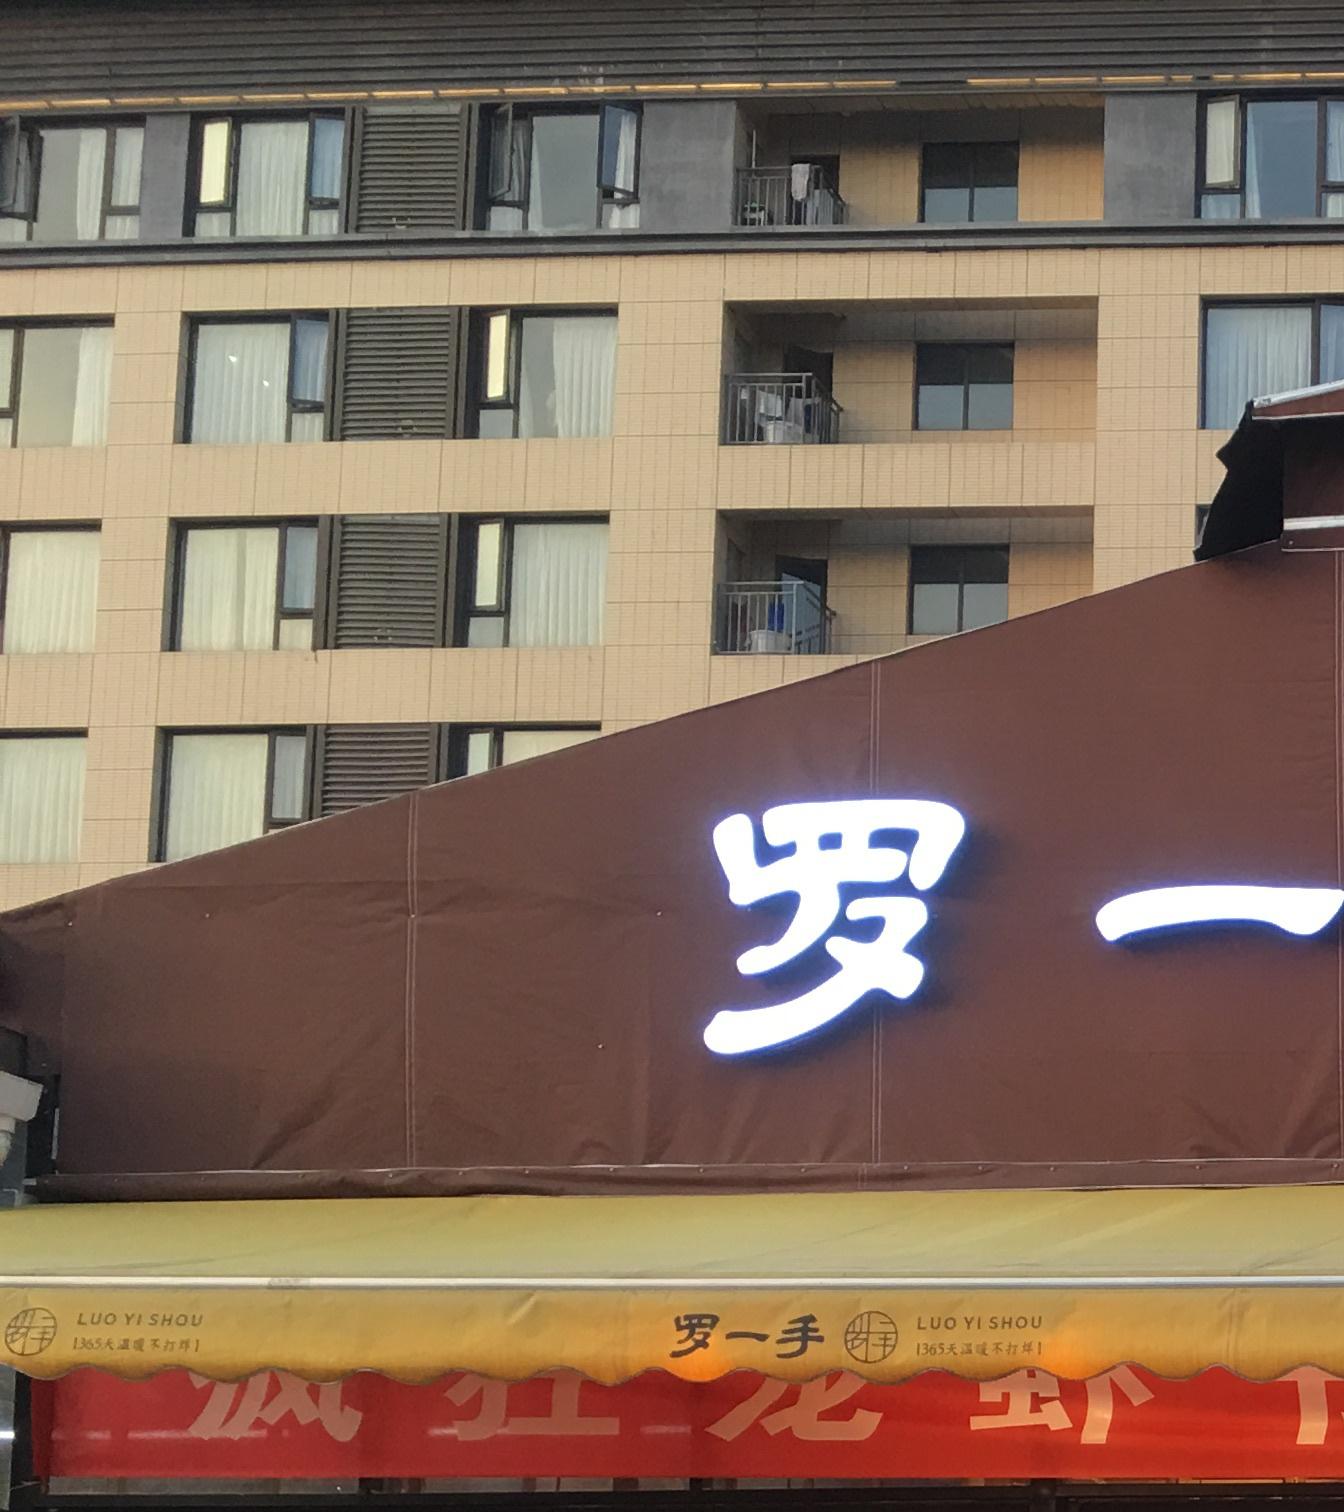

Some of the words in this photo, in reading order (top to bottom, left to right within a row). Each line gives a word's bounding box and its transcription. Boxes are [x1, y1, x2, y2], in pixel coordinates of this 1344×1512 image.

[78, 1312, 117, 1326] LUO
[124, 1313, 142, 1326] YI
[149, 1313, 204, 1327] SHOU
[916, 1315, 957, 1331] LUO
[964, 1315, 982, 1330] YI
[988, 1314, 1043, 1330] SHOU
[669, 1312, 825, 1360] 罗一手
